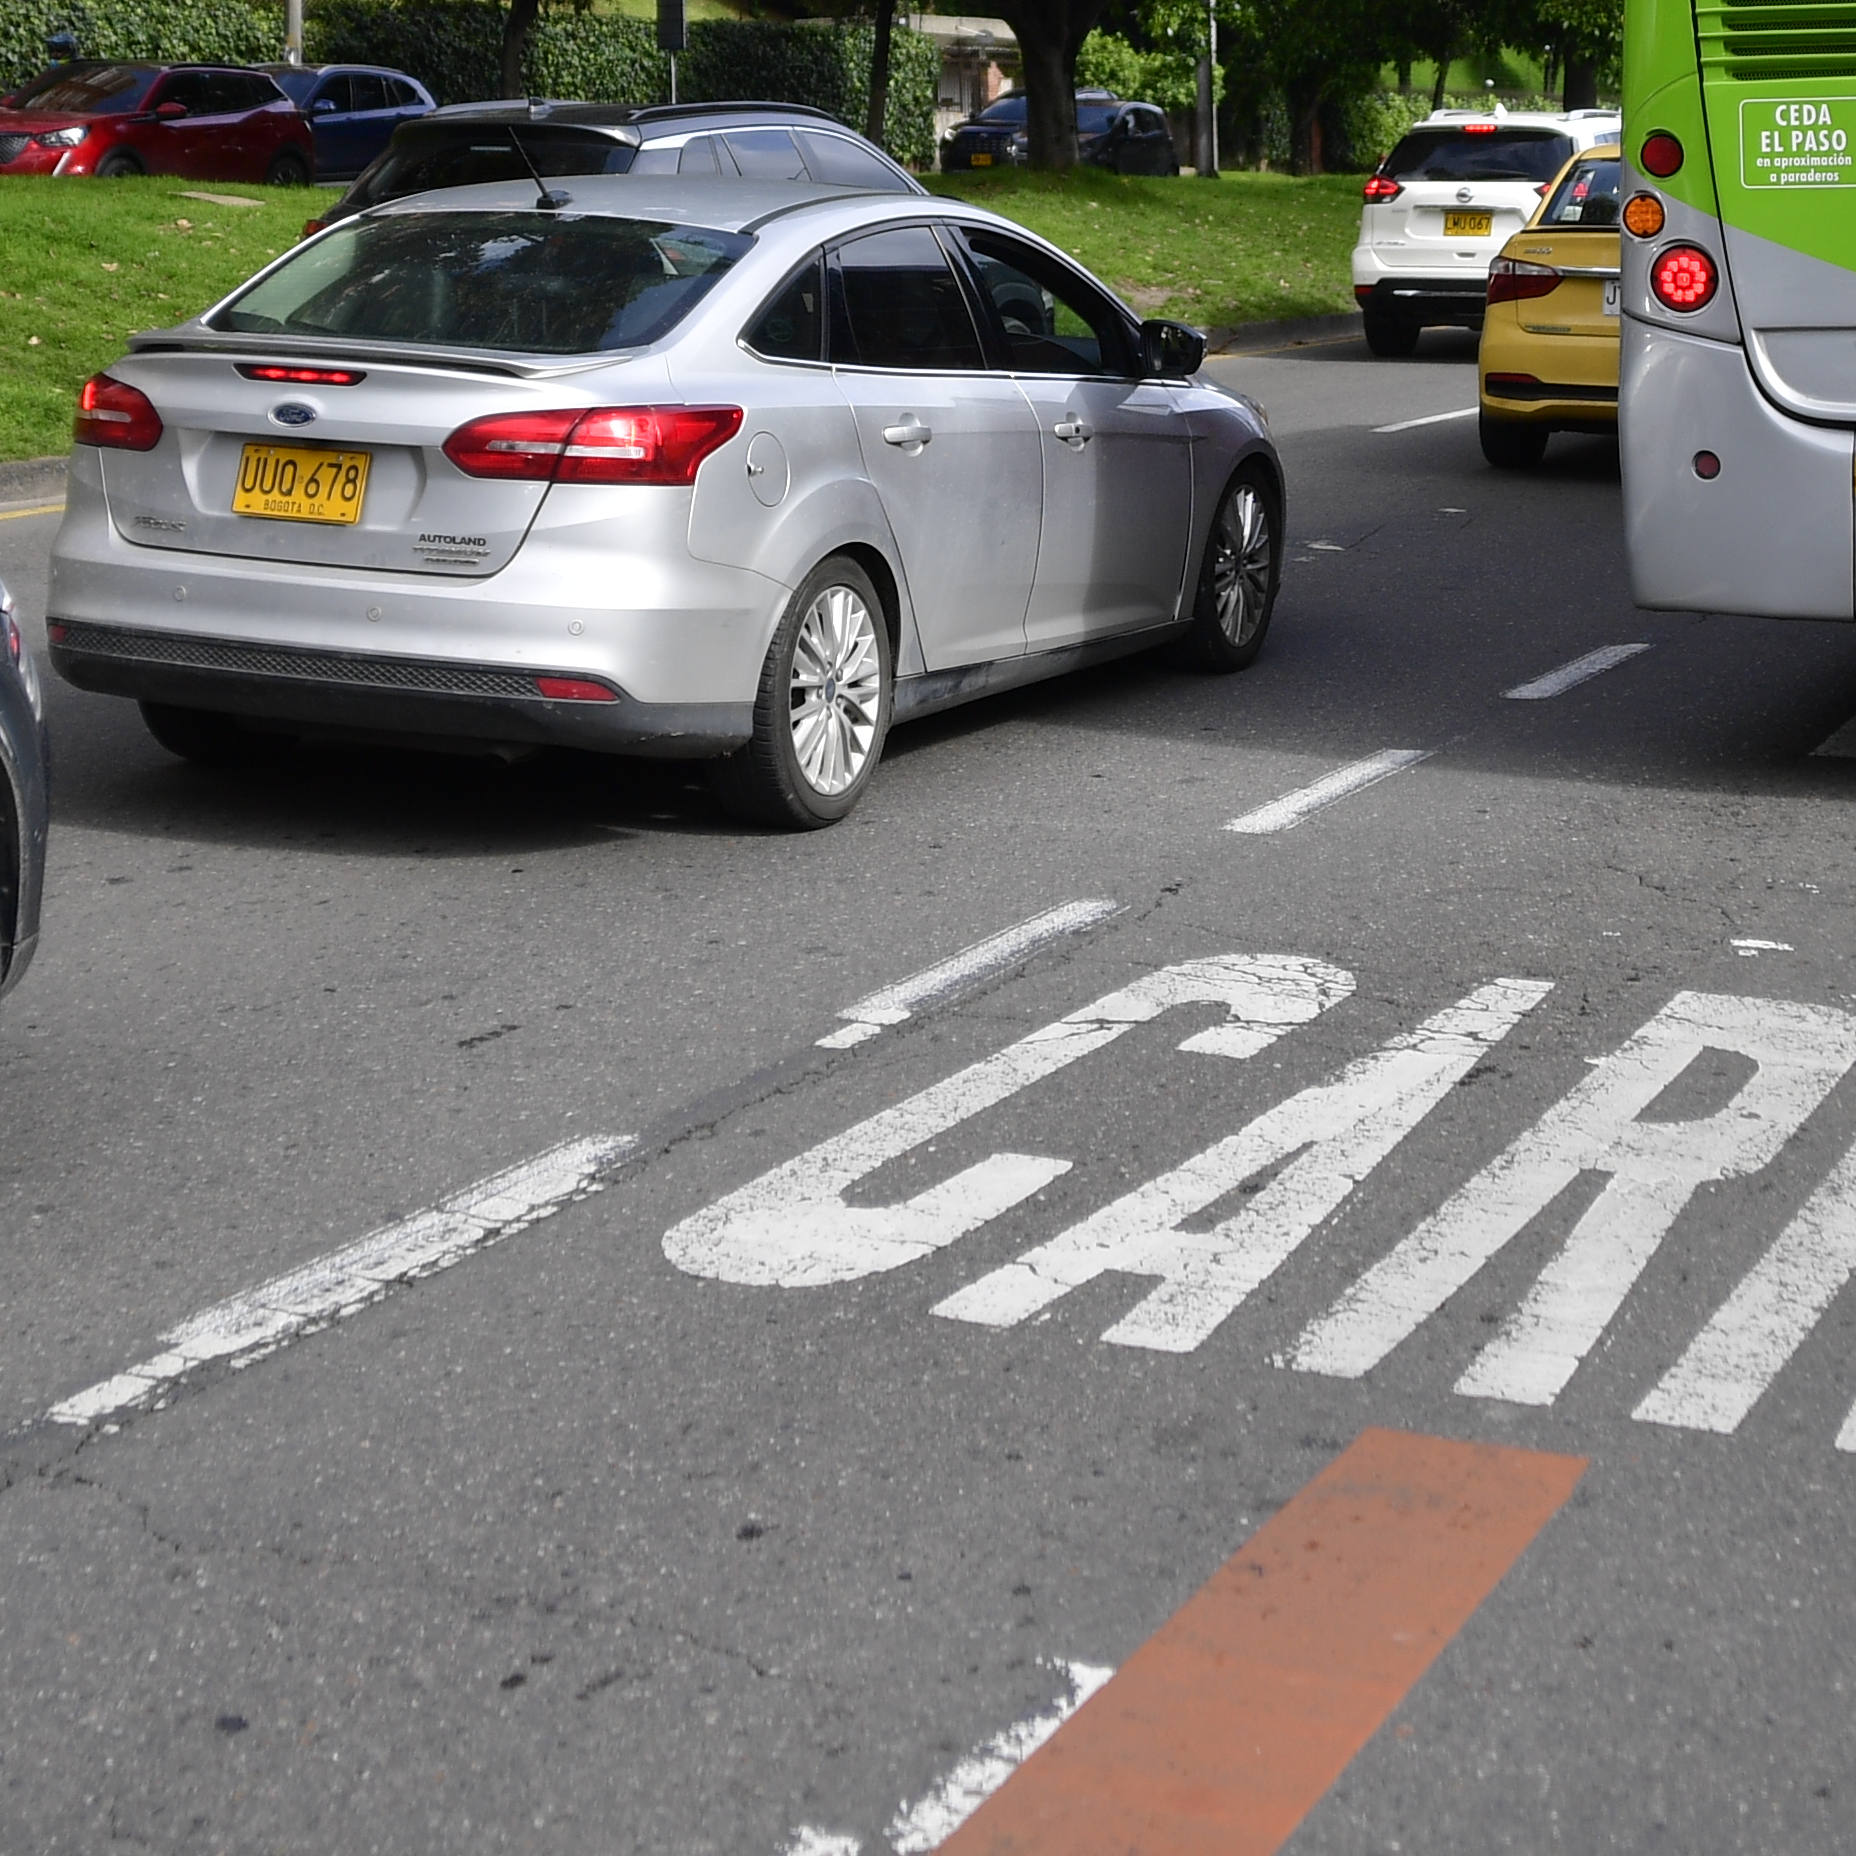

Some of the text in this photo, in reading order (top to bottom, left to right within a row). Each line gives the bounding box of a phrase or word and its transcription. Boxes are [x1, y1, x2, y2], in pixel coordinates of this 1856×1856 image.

[1775, 103, 1832, 127] CEDA
[1760, 129, 1847, 153] EL PASO
[1756, 153, 1852, 170] en aproximación
[1770, 170, 1840, 185] a paraderos
[1469, 217, 1491, 231] 067
[241, 455, 360, 503] UUQ 678
[263, 498, 302, 514] BOGOTA
[418, 533, 487, 547] AUTOLAND
